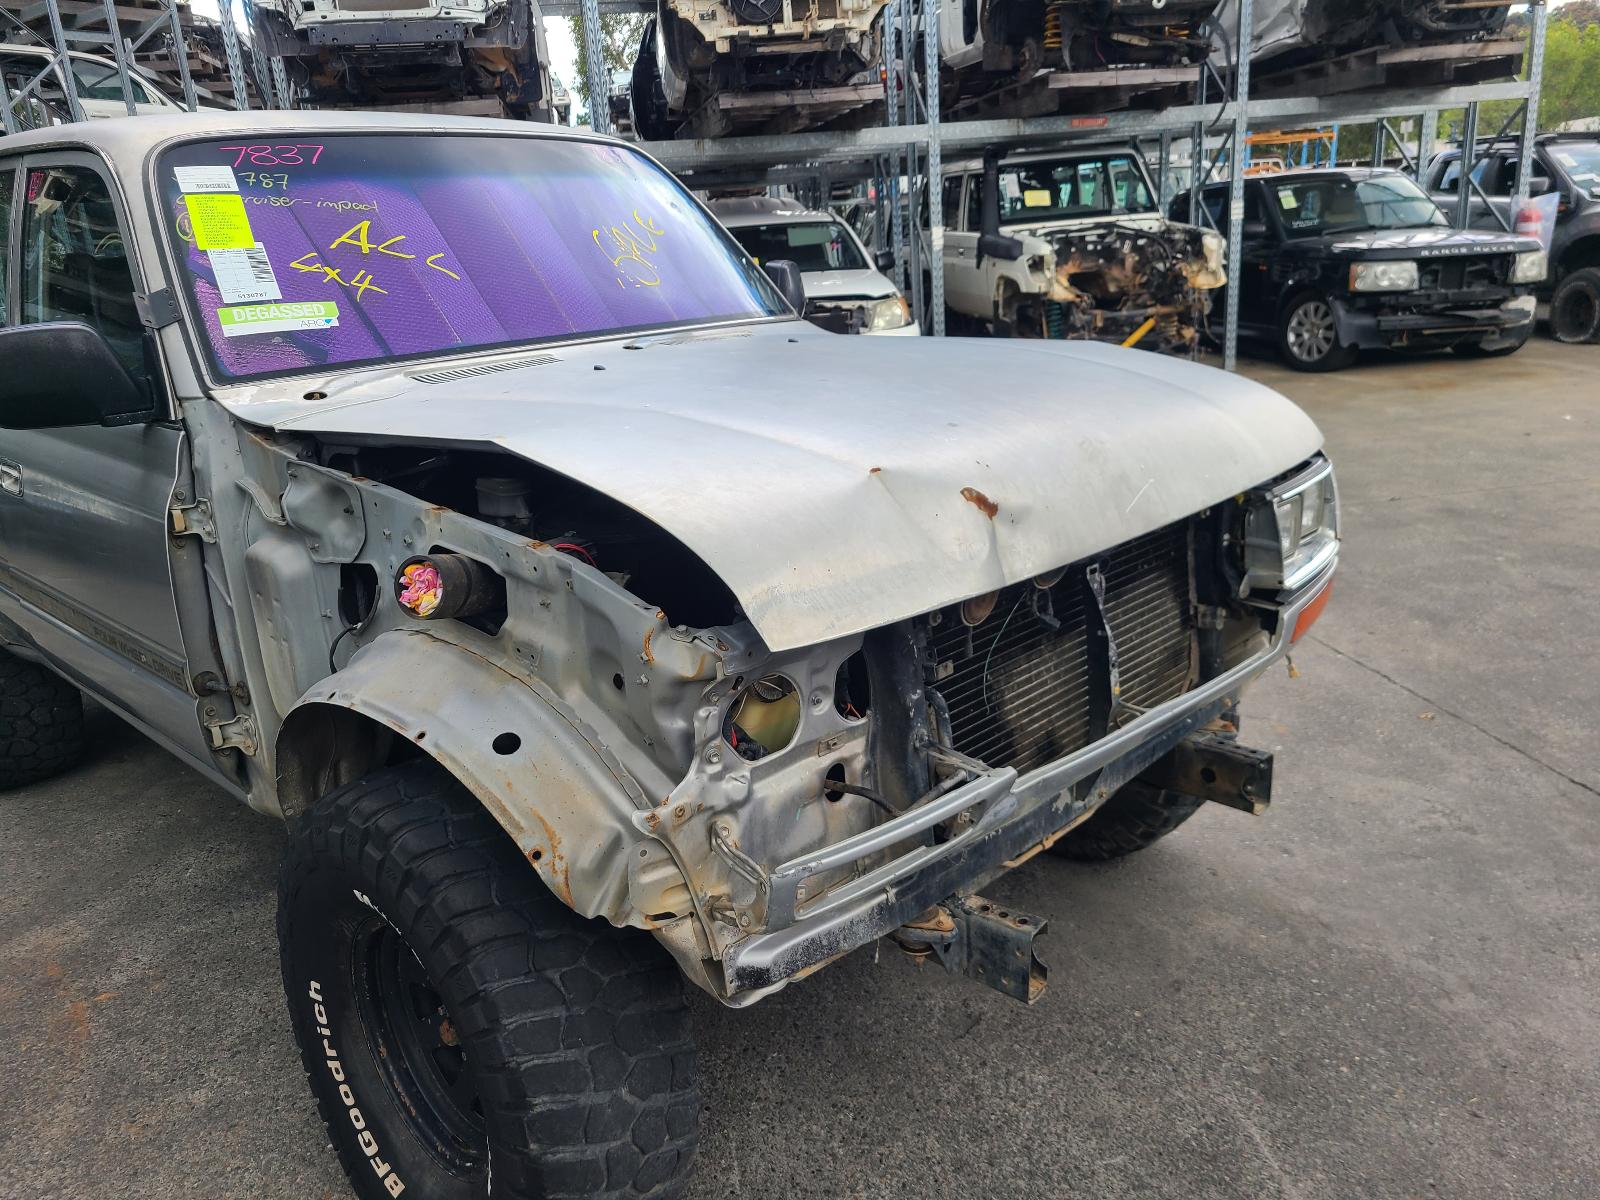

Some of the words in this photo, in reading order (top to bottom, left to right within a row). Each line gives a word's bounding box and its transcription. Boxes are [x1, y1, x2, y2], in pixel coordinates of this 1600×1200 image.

[219, 145, 324, 168] 7837
[1421, 247, 1467, 256] RANGE
[231, 303, 326, 322] DEGASSED
[308, 980, 406, 1199] BFGoodrich
